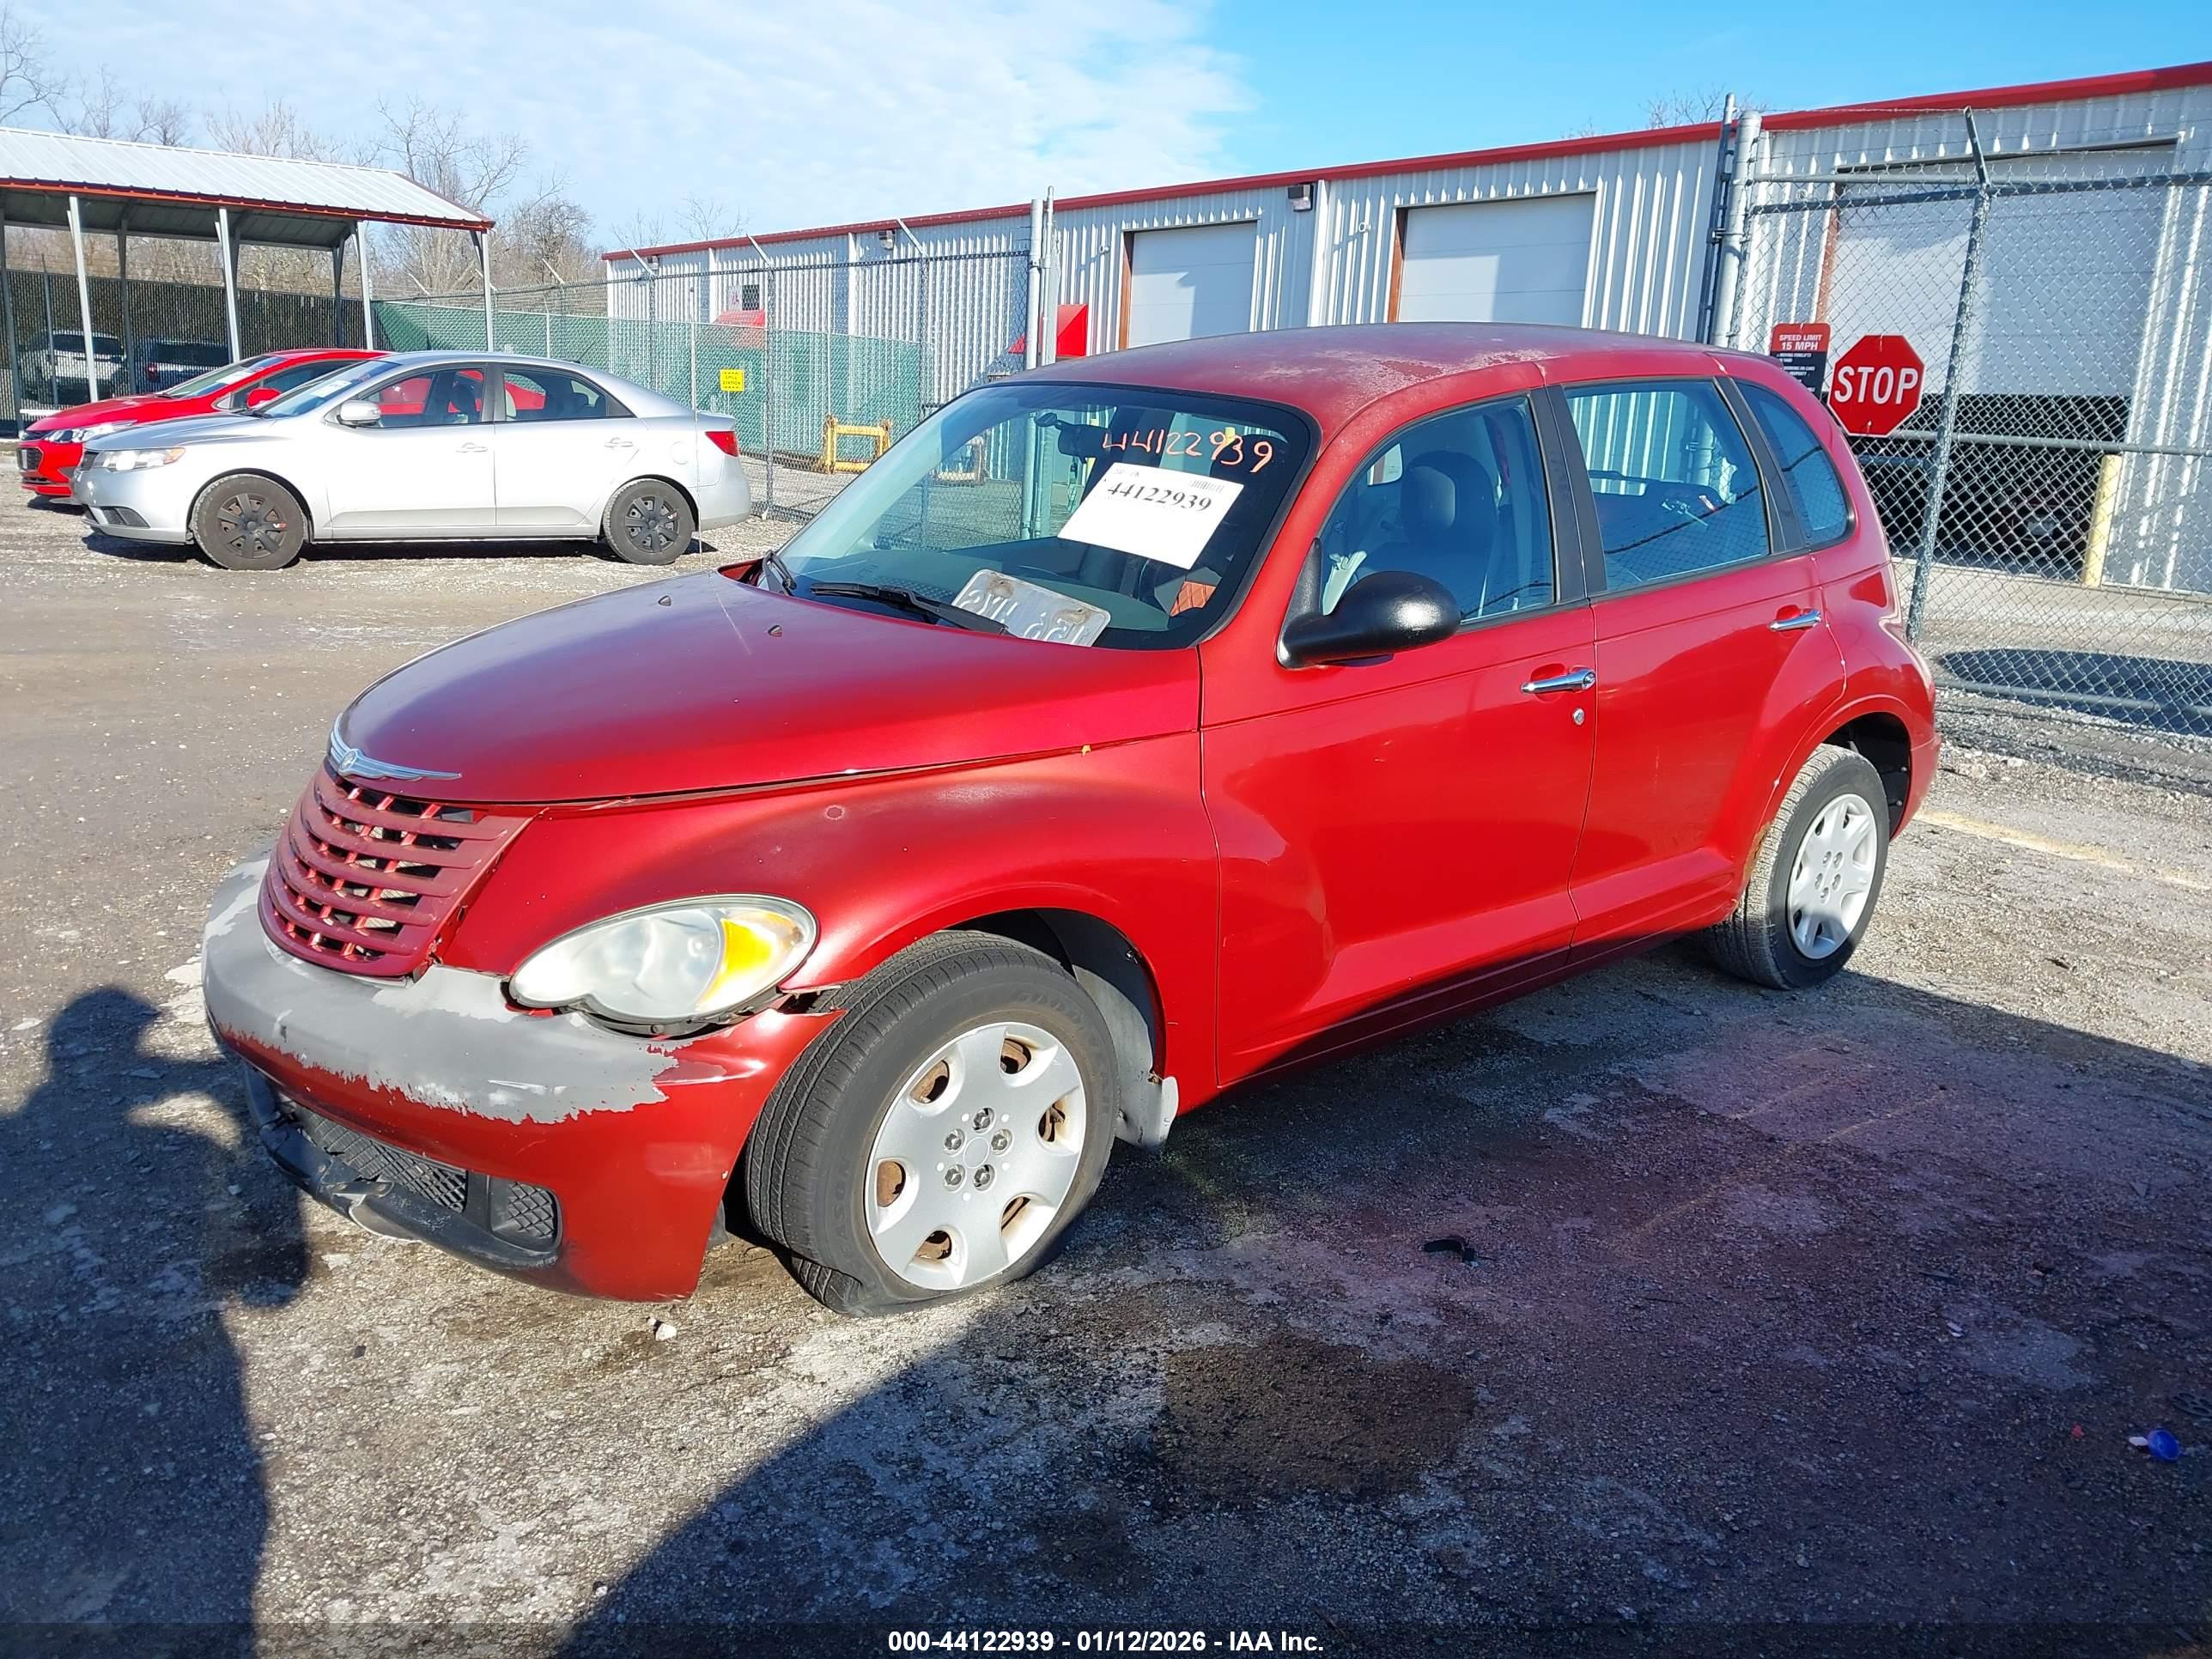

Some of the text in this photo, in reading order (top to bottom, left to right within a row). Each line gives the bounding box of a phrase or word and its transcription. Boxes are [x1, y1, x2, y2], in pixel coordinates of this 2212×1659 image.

[1782, 341, 1819, 350] 15 MPH
[1834, 366, 1918, 404] STOP
[1103, 428, 1273, 473] 44122939
[1108, 482, 1212, 512] 44122939
